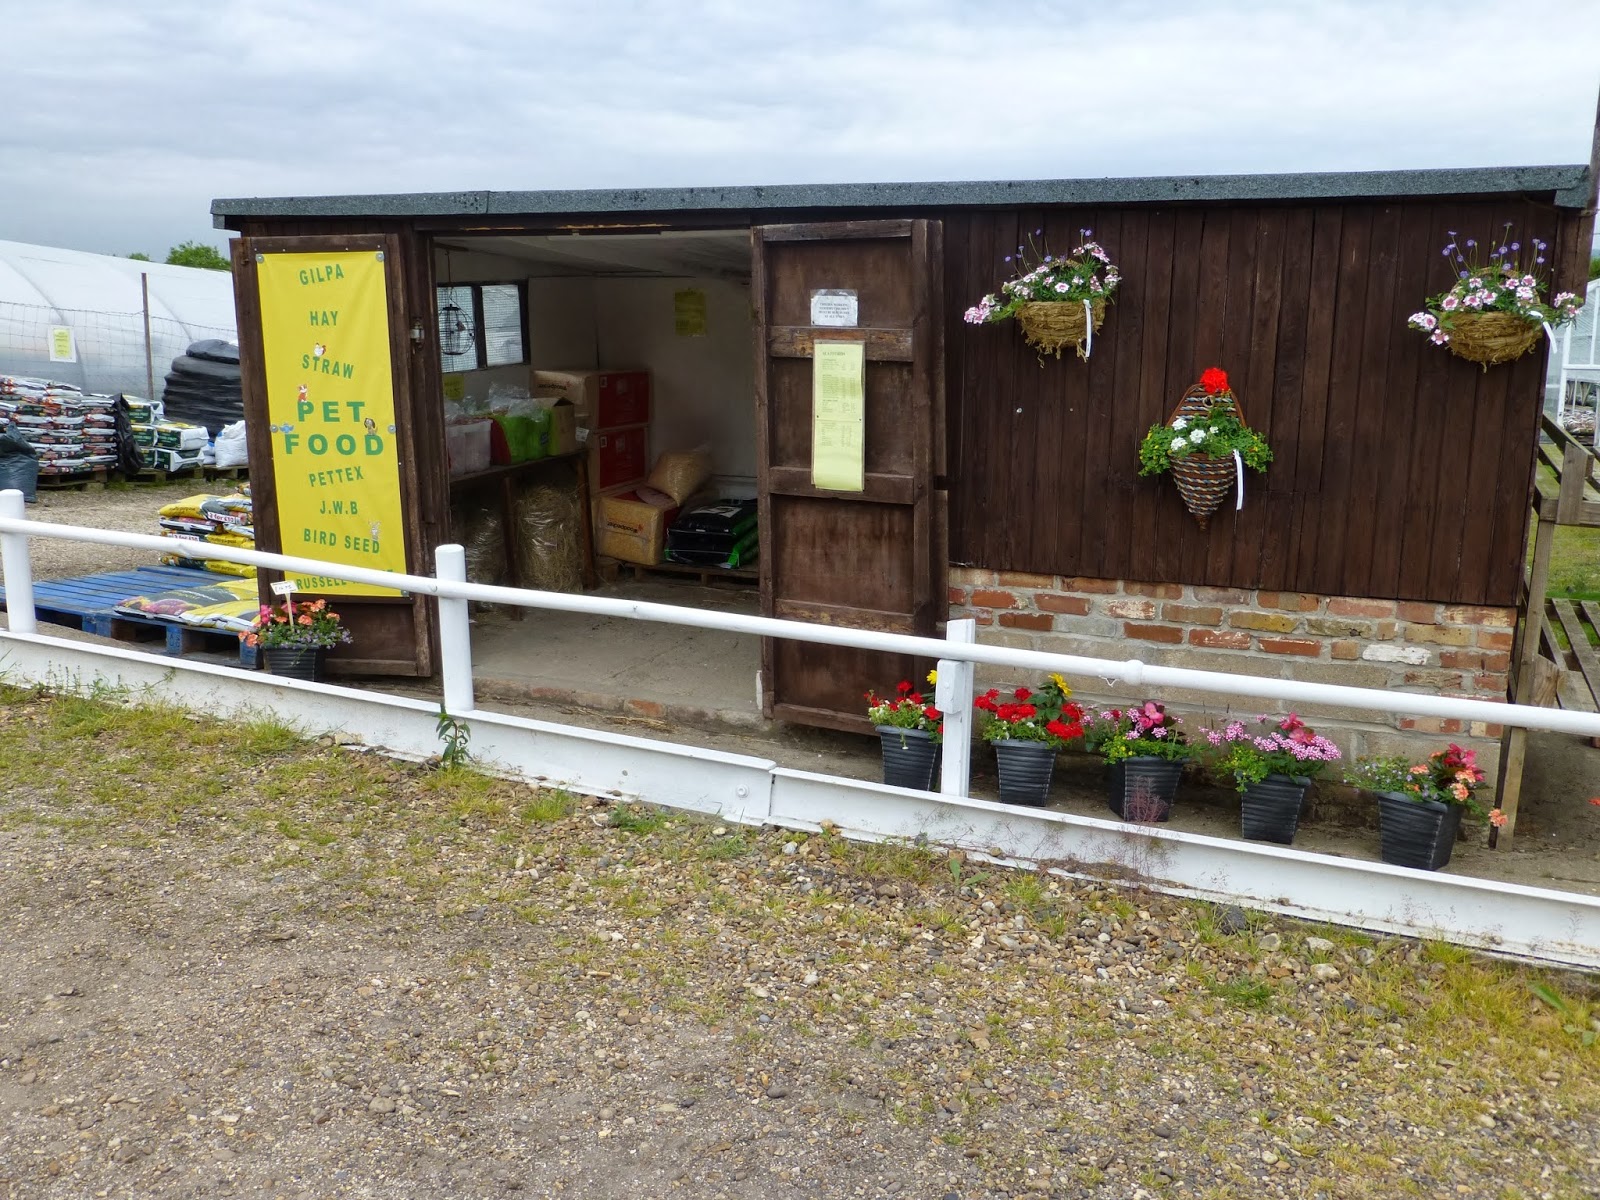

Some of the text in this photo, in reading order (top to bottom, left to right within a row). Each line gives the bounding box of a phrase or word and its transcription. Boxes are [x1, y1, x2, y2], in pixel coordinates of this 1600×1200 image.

[299, 264, 344, 285] GILPA
[309, 310, 339, 327] HAY
[302, 354, 354, 379] STRAW
[297, 401, 366, 423] PET
[284, 433, 384, 456] FOOD
[309, 466, 364, 487] PETTEX
[319, 500, 358, 516] J.W.B
[304, 528, 380, 554] BIRD SEED
